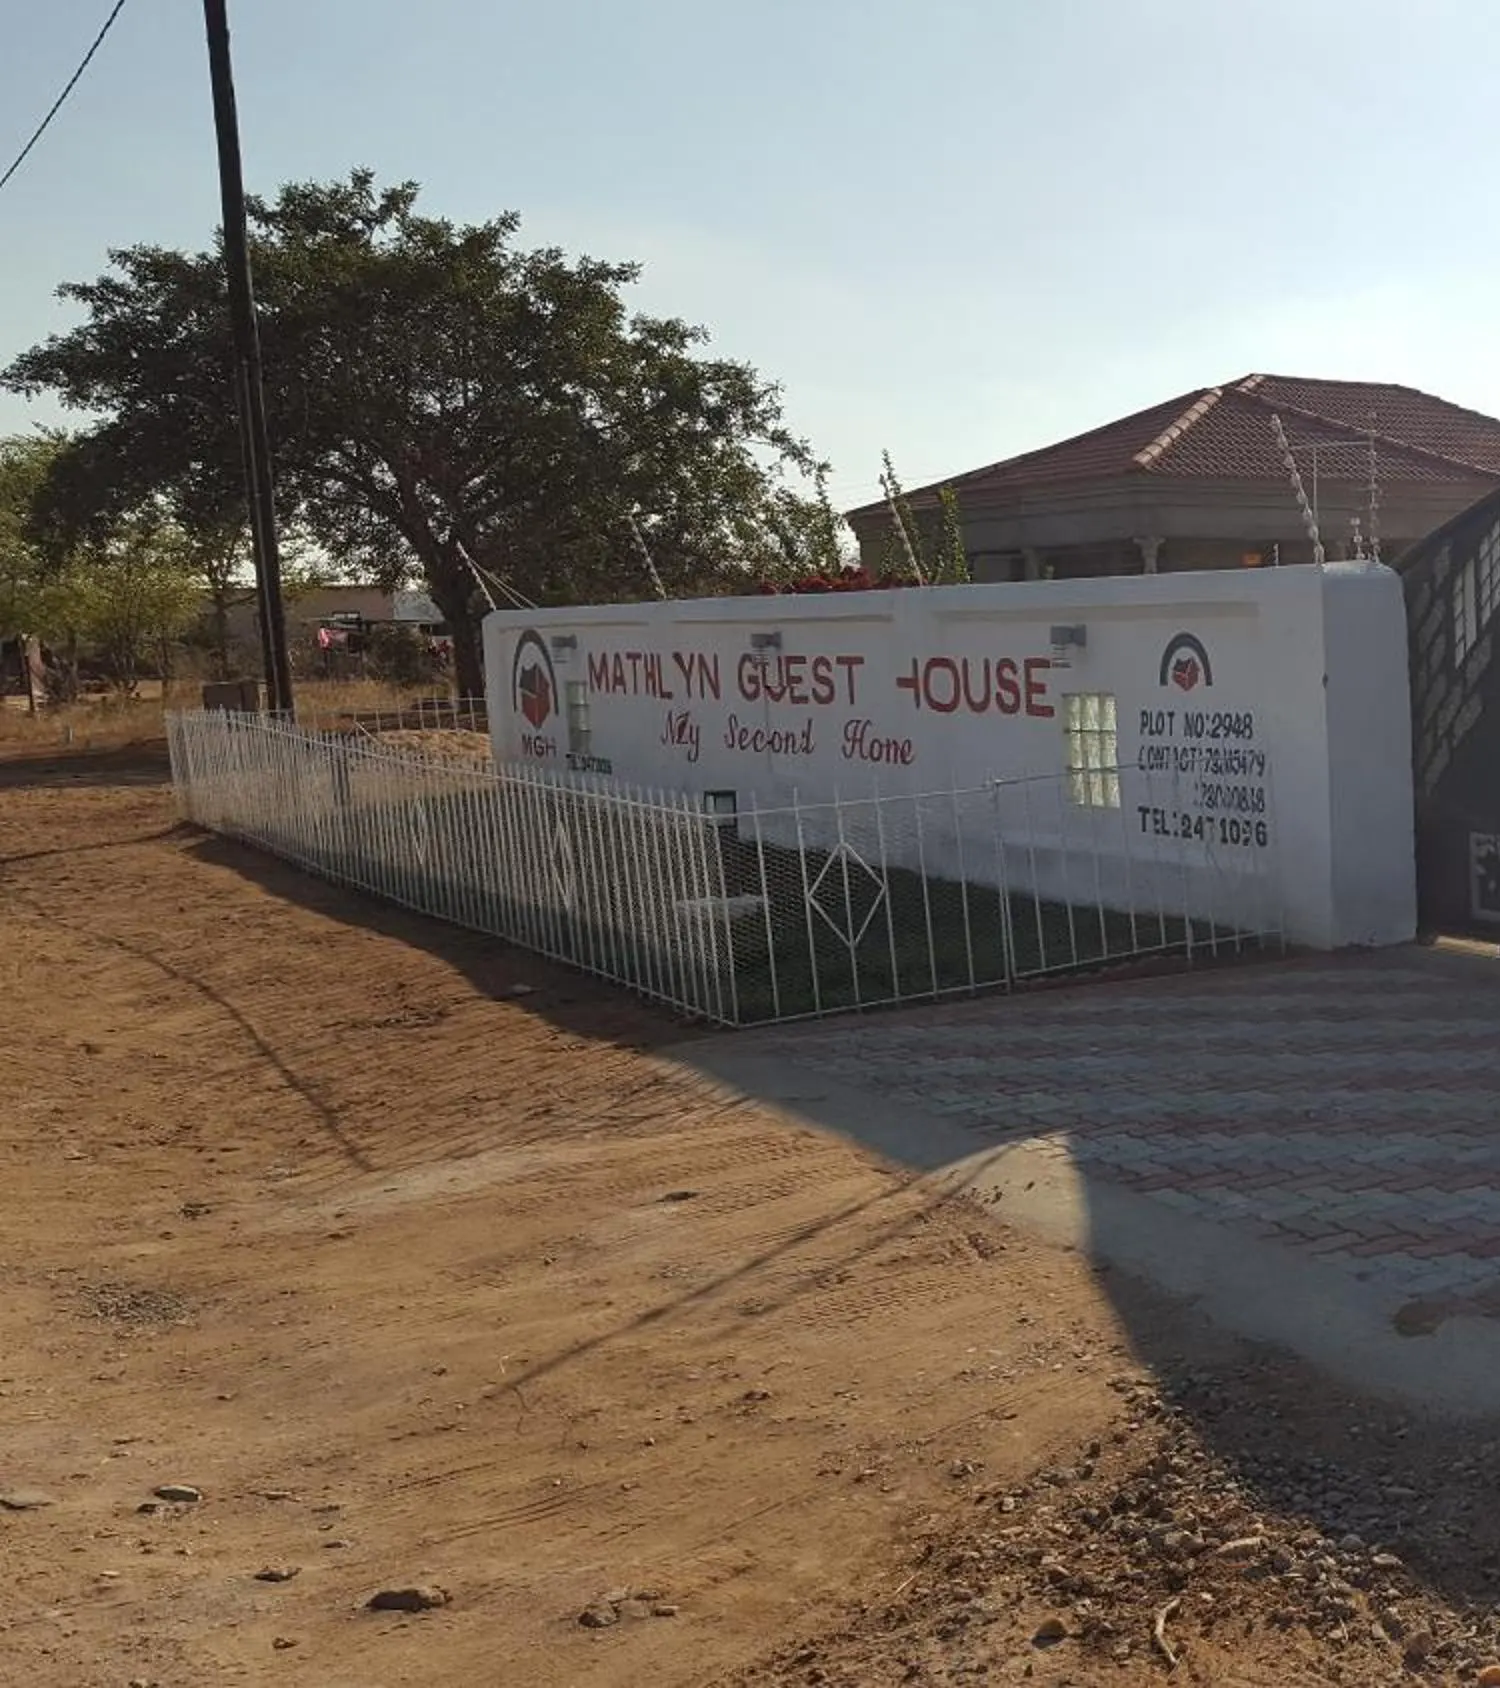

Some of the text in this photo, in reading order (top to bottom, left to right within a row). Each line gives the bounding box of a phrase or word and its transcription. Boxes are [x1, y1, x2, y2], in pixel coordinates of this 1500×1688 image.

[587, 651, 1056, 718] MATHLYN GUEST HOUSE
[723, 714, 815, 755] Second
[842, 717, 915, 765] Home
[1139, 710, 1254, 740] PLOT NO:2948
[521, 734, 558, 758] MGH
